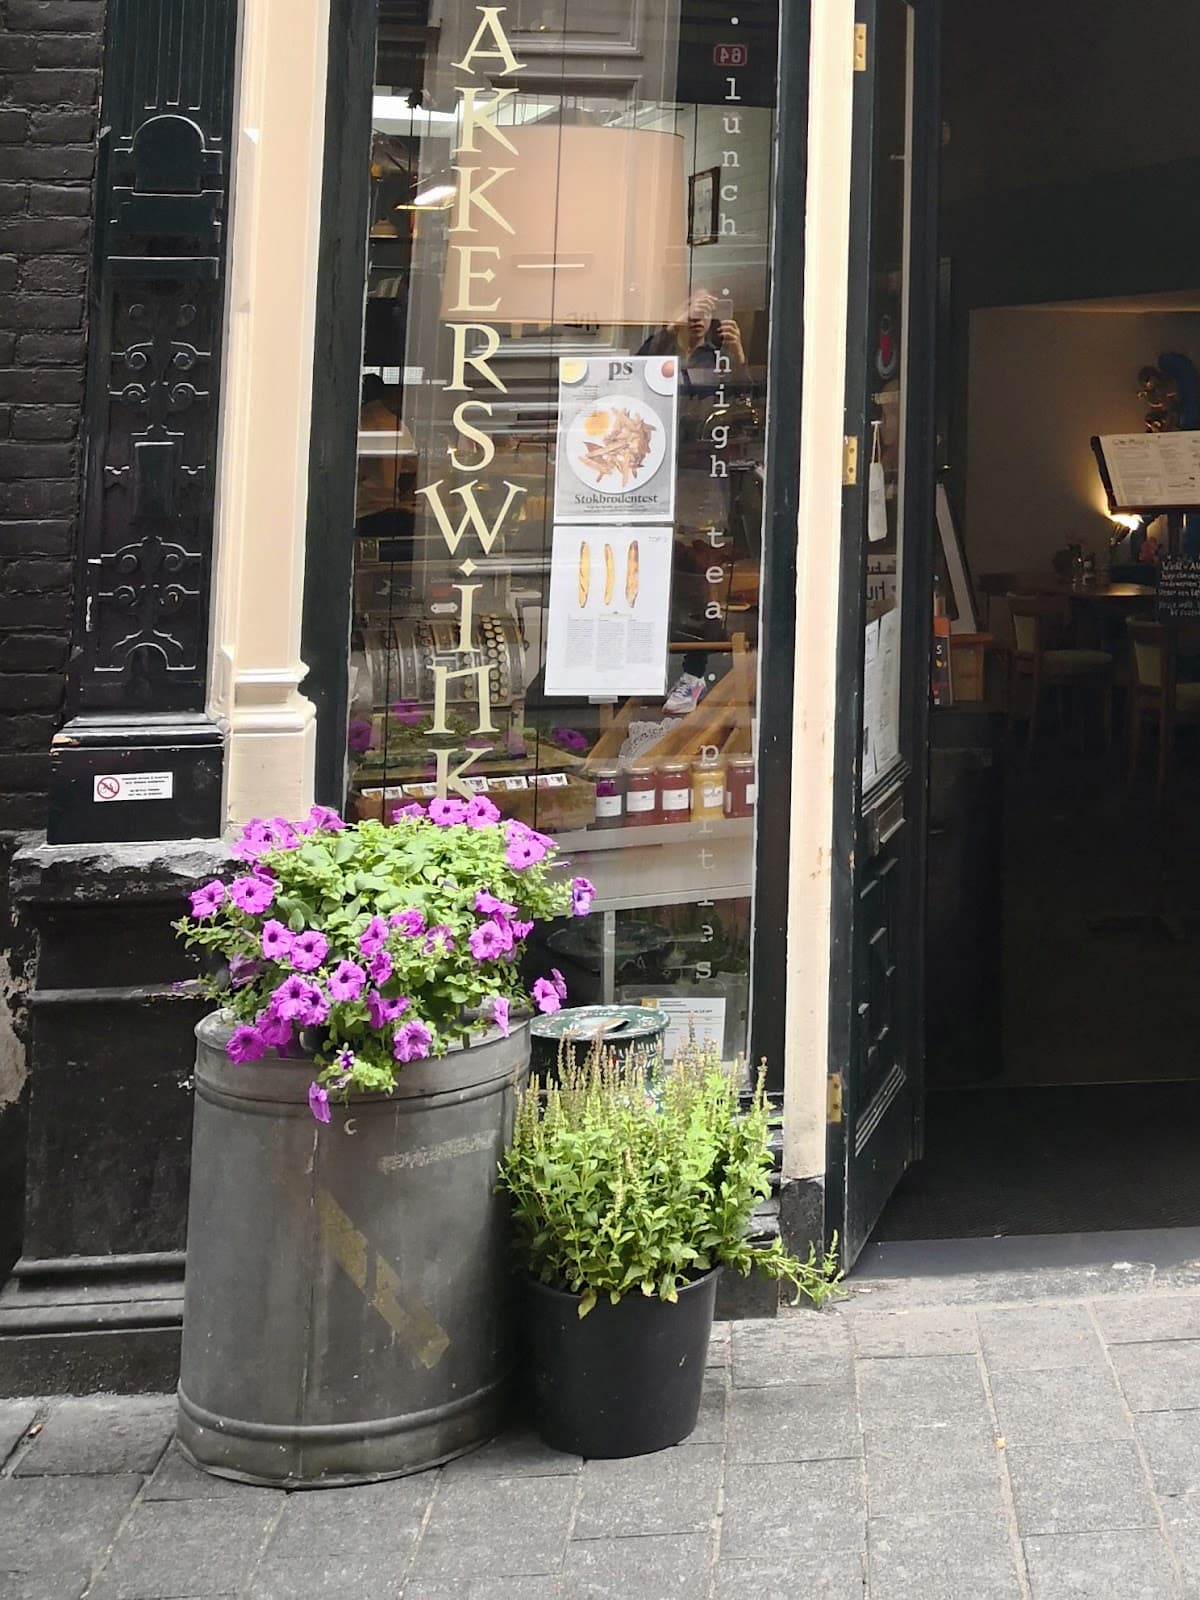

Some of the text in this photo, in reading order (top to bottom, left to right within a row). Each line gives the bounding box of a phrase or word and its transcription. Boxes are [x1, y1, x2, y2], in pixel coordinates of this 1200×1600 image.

[717, 77, 742, 237] lunch
[608, 361, 633, 381] ps
[703, 350, 732, 620] high tea
[695, 744, 719, 979] pates
